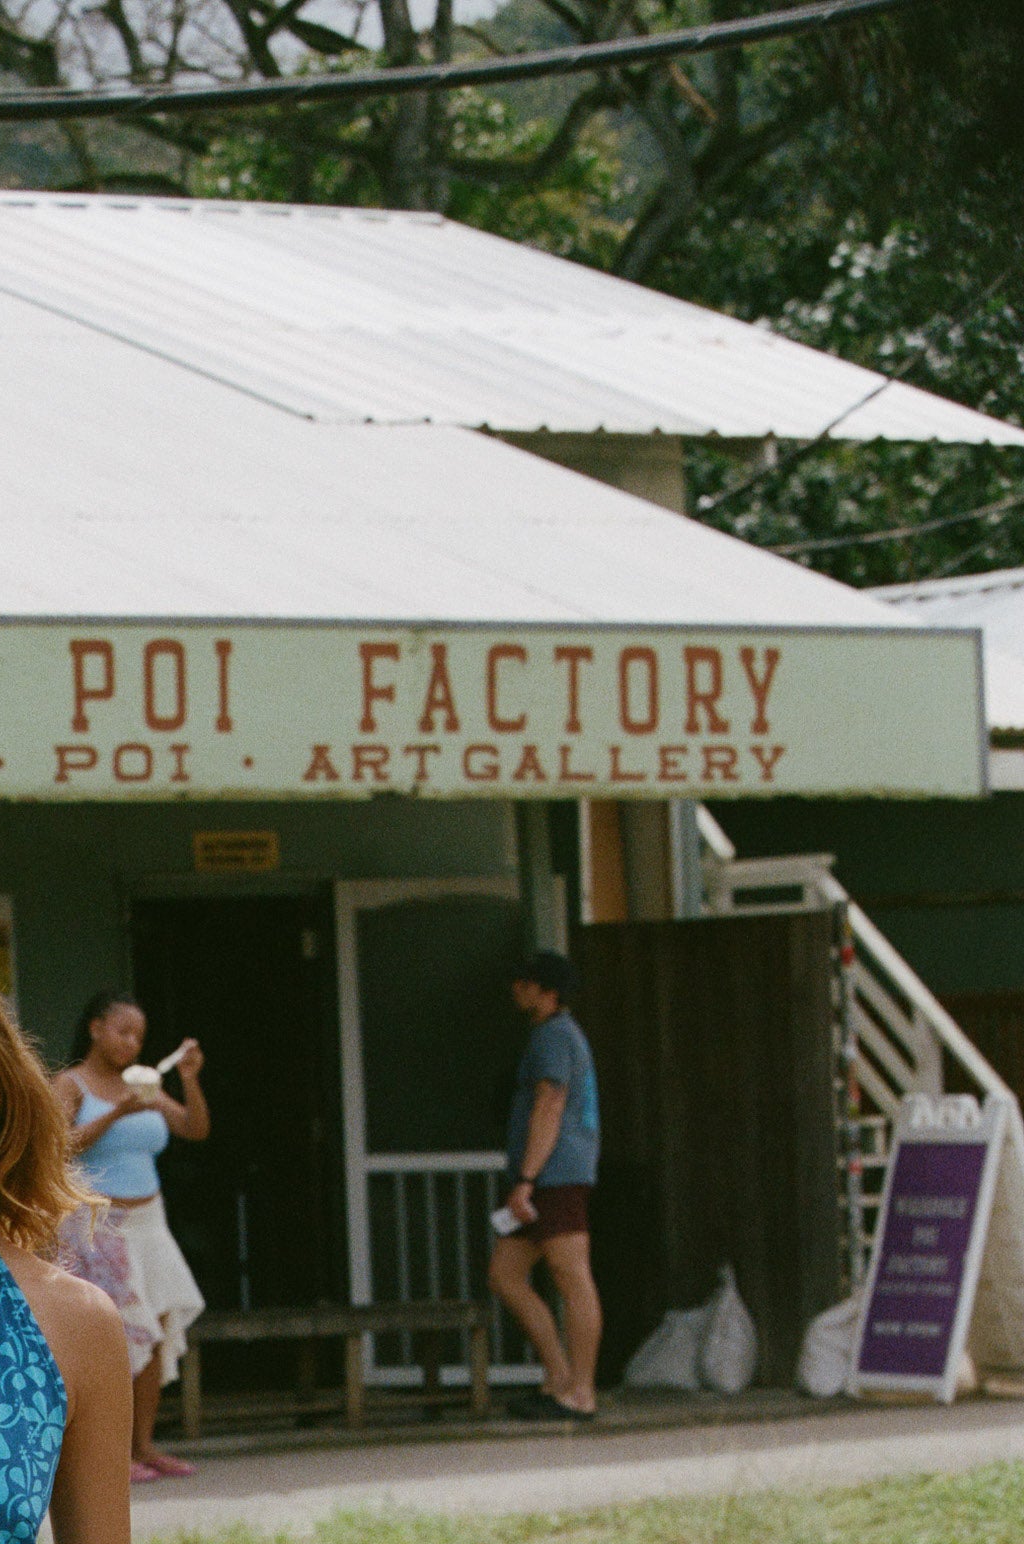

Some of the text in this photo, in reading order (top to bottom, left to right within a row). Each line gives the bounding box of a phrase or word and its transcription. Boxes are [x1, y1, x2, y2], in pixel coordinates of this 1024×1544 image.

[69, 637, 234, 736] POI
[357, 640, 781, 738] FACTORY
[54, 742, 190, 785] POI
